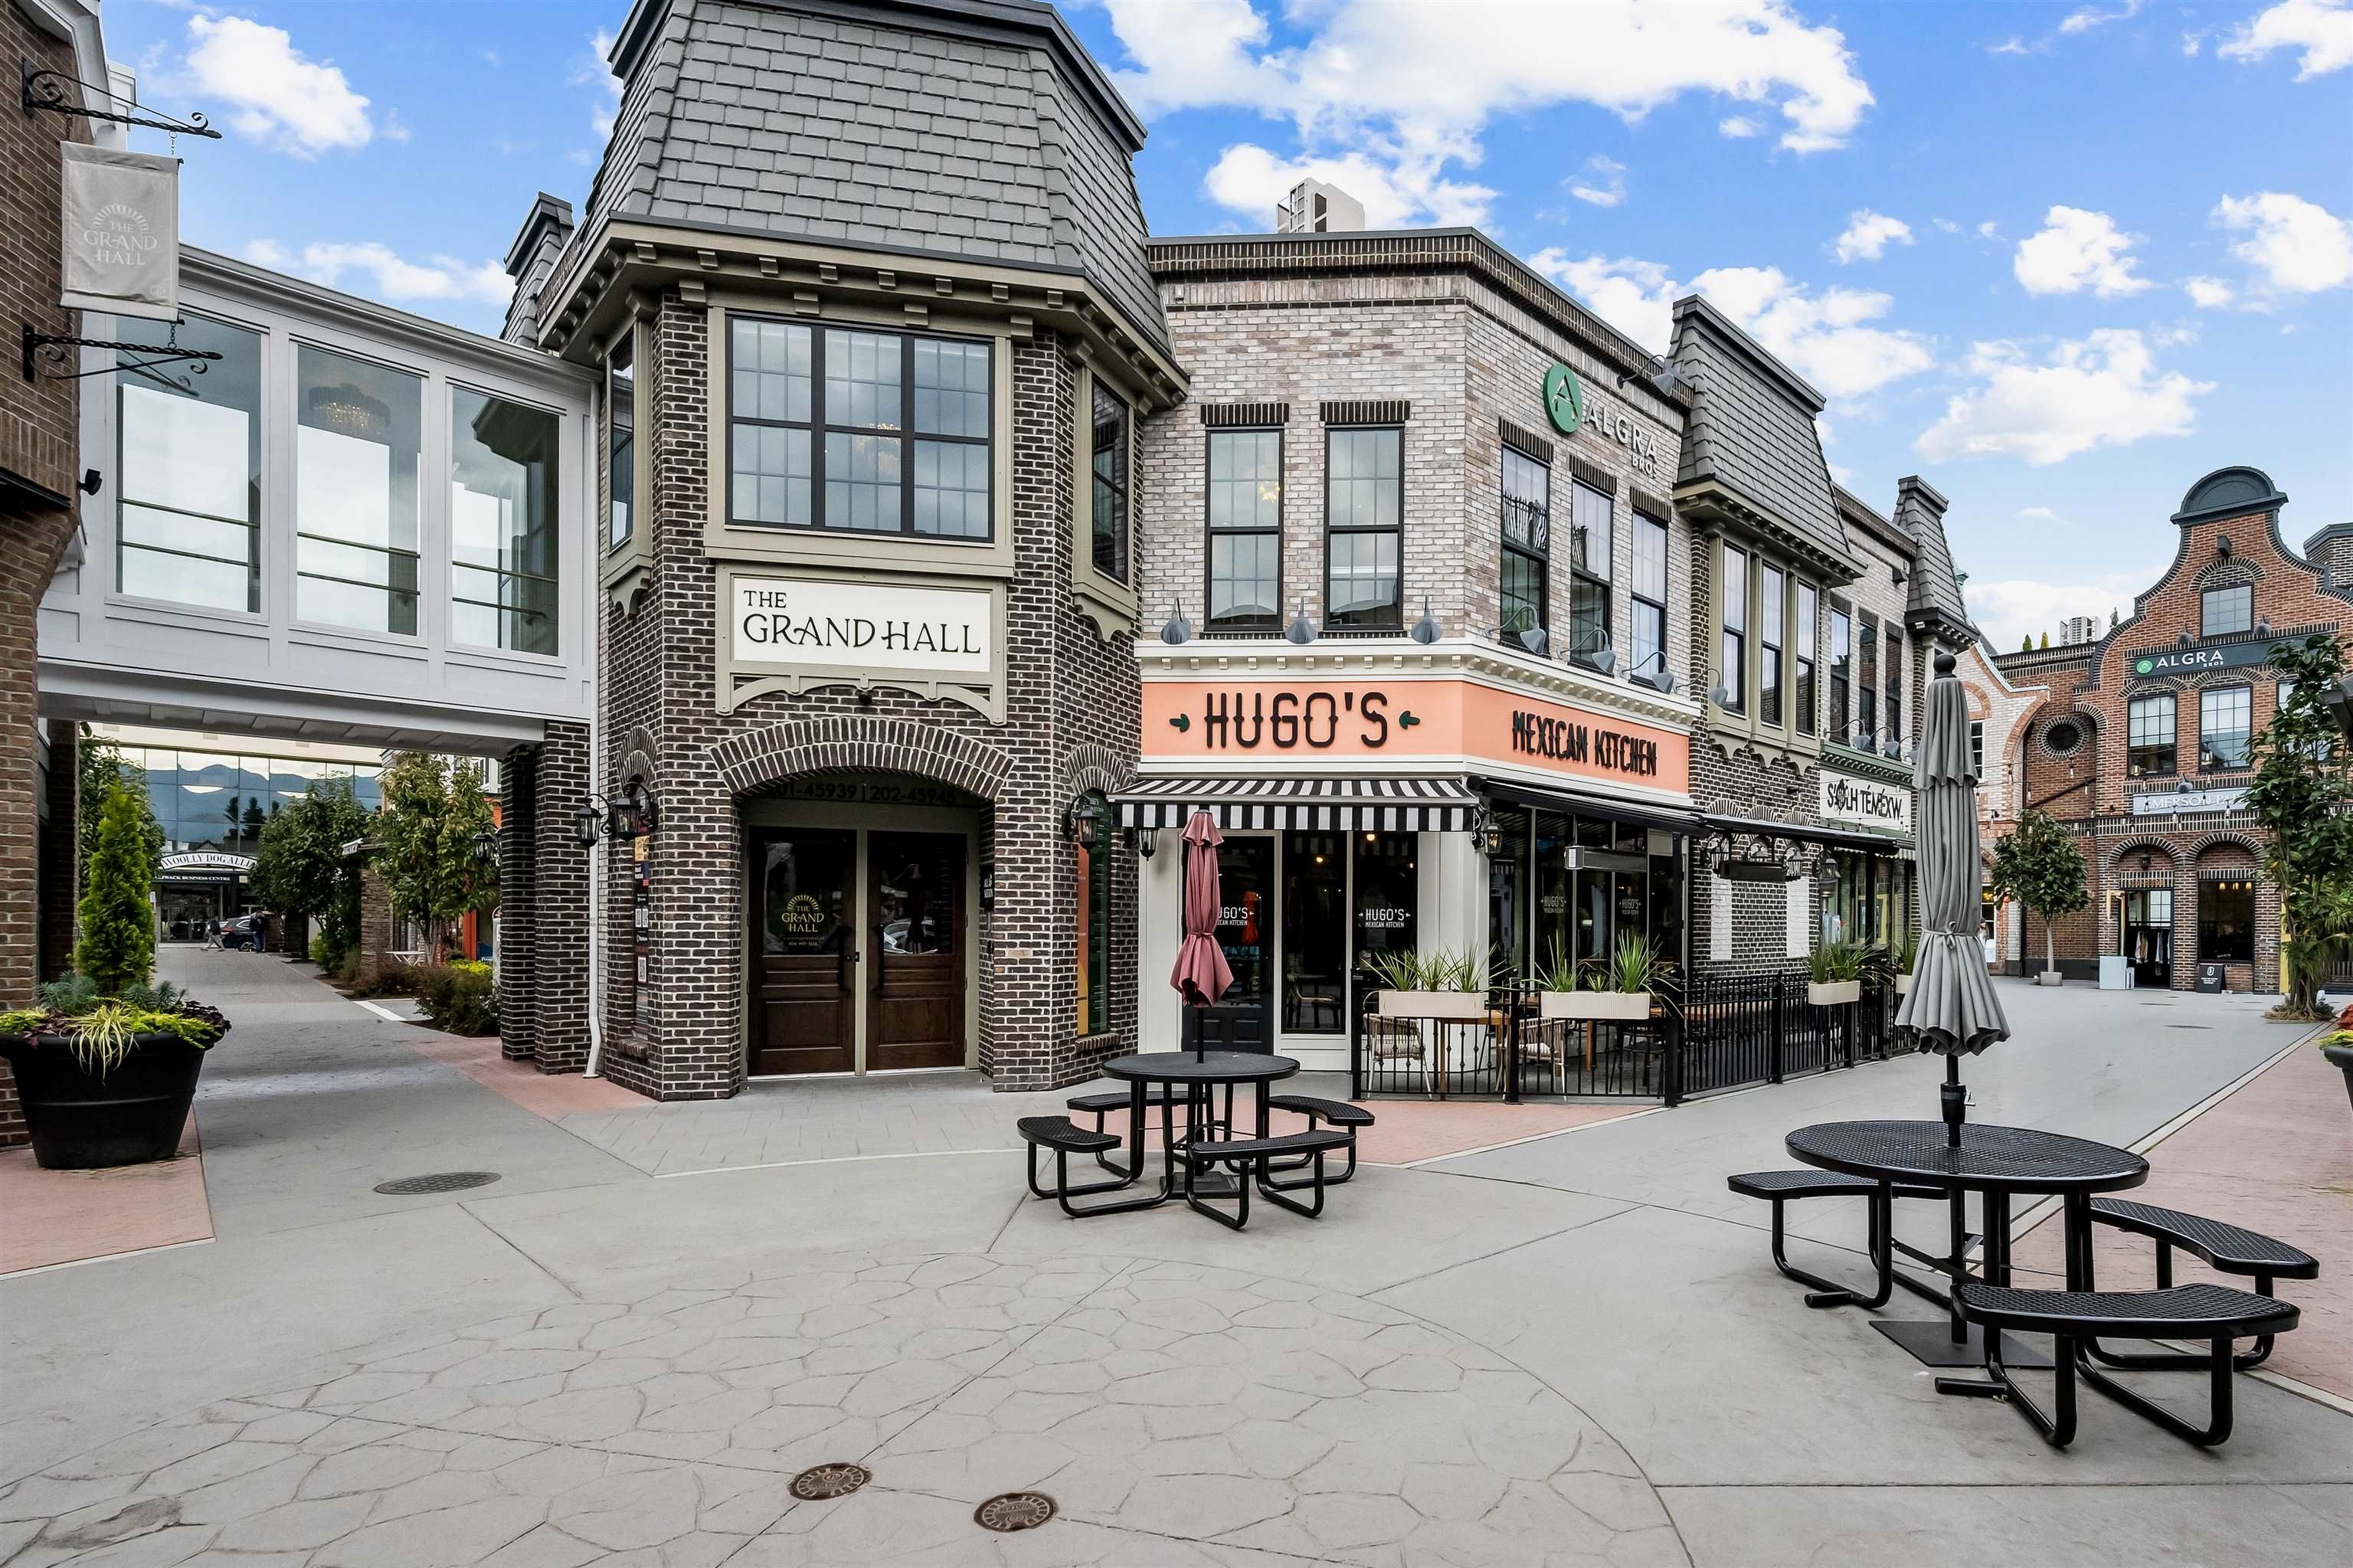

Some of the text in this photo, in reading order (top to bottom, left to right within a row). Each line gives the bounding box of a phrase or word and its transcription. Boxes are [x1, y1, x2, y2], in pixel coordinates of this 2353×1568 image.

[110, 221, 135, 233] THE
[83, 230, 158, 251] GRAND
[97, 249, 146, 265] HALL
[1584, 398, 1657, 463] ALGRA
[1631, 453, 1657, 479] BROS
[743, 590, 787, 608] THE
[743, 613, 981, 653] GRAND HALL
[2156, 650, 2224, 669] ALGRA
[1204, 692, 1388, 748] HUGO'S
[1513, 710, 1658, 777] MEXICAN KITCHEN
[162, 854, 203, 867] WOOLLY
[206, 854, 225, 863] DOG
[781, 912, 825, 923] GRAND
[1366, 908, 1405, 921] HUGO'S
[789, 924, 819, 932] HALL
